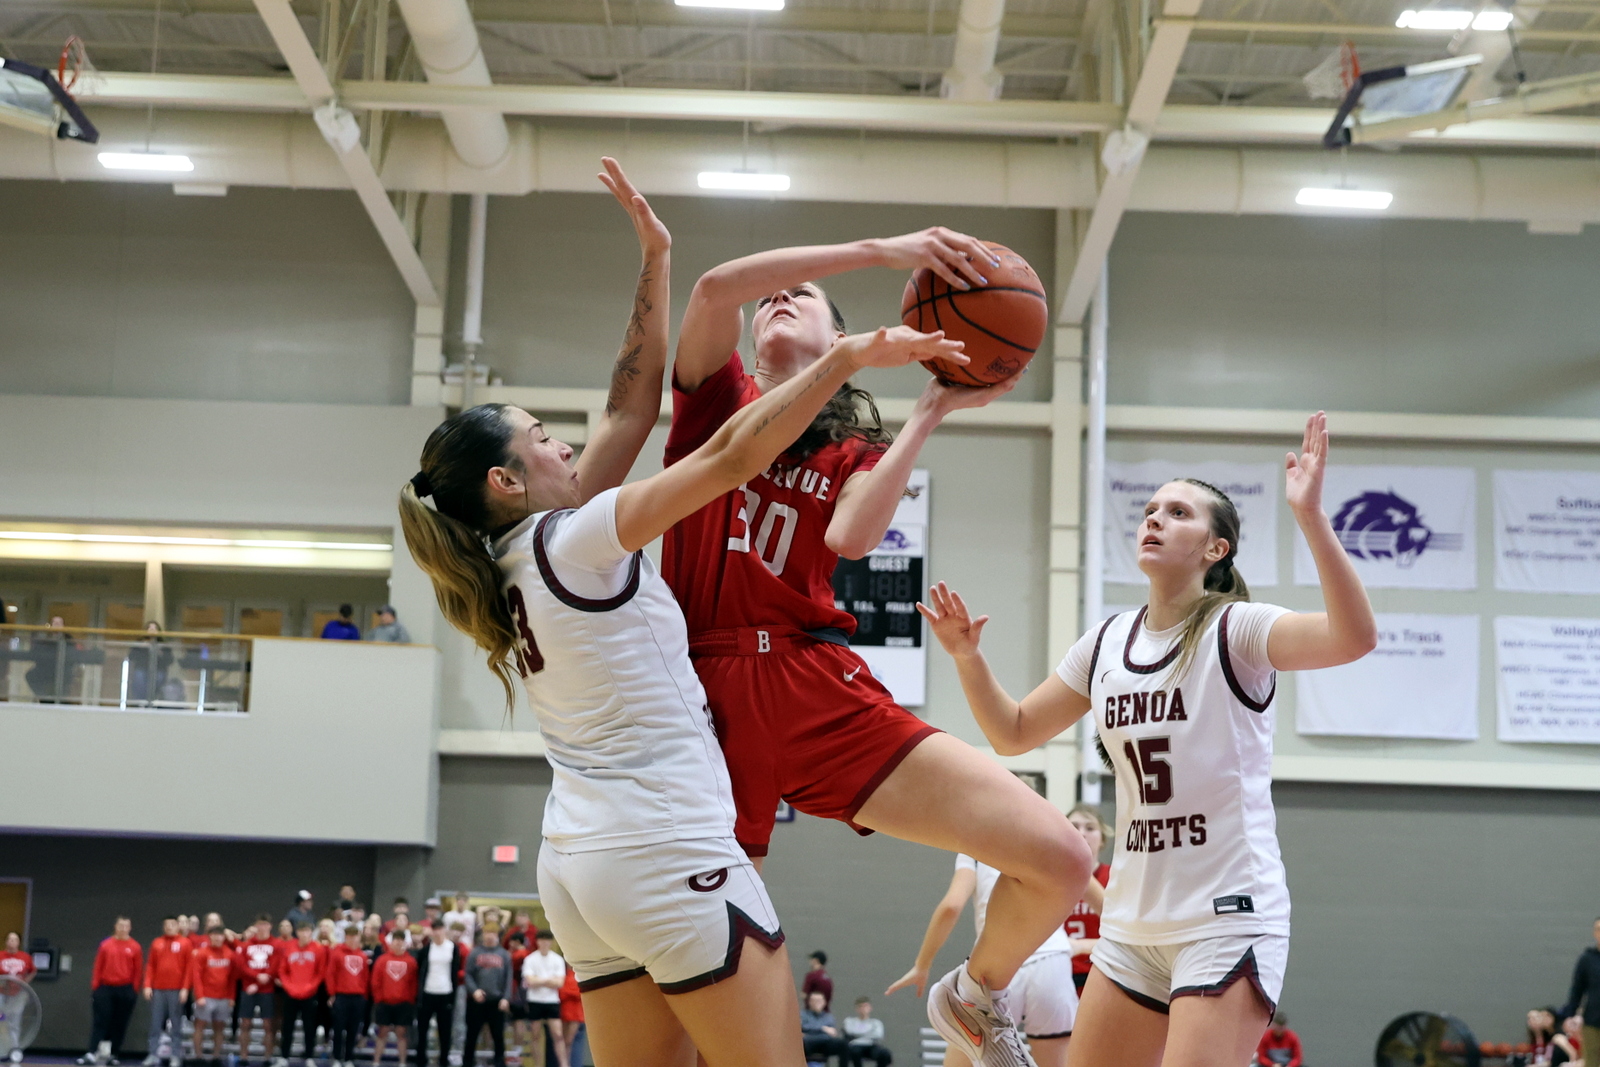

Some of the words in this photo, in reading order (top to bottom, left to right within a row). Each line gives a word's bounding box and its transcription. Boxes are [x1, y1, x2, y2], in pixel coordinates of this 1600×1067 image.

[761, 463, 831, 501] LEVUE
[727, 483, 799, 577] 30
[869, 556, 911, 572] GUEST
[507, 583, 545, 679] 3
[757, 630, 771, 654] B
[1105, 687, 1188, 729] GENOA
[1123, 735, 1175, 806] 15
[1126, 813, 1207, 853] COMETS
